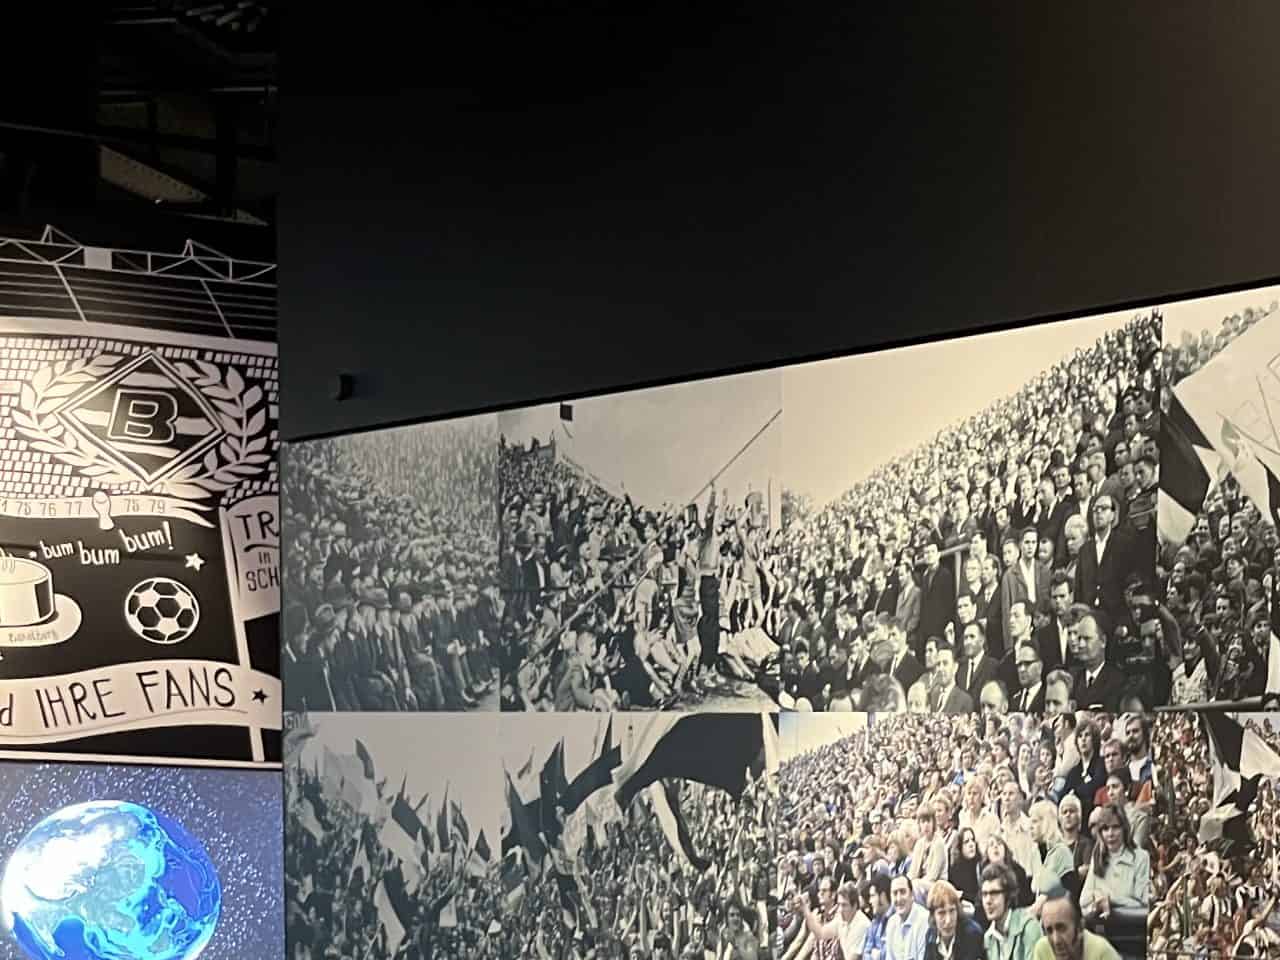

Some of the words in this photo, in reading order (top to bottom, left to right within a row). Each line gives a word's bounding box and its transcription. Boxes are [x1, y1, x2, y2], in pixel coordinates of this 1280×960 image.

[64, 502, 82, 515] 77
[40, 540, 74, 560] bum
[78, 541, 120, 565] bum
[119, 520, 173, 552] bum!
[36, 679, 126, 728] IHRE
[136, 667, 236, 713] FANS
